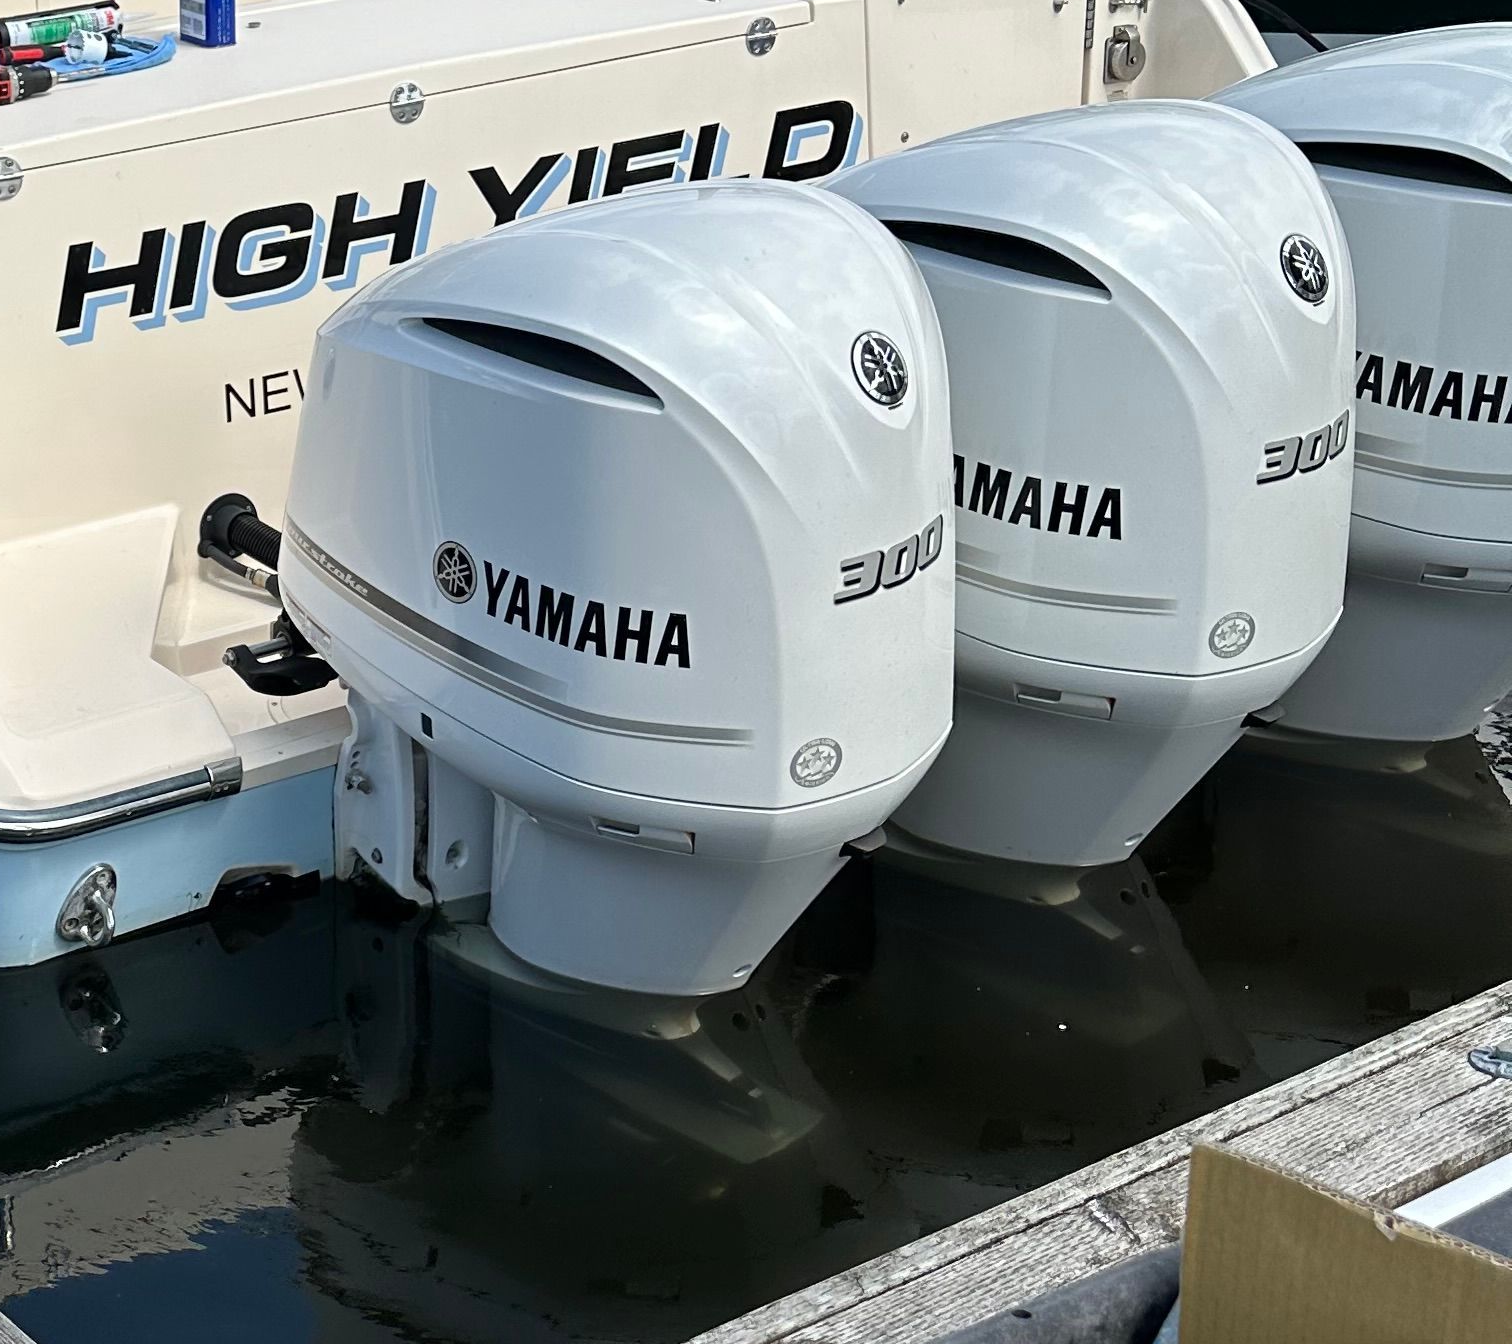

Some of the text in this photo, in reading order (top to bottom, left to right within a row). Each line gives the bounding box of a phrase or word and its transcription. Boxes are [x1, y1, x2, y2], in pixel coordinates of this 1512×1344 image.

[103, 9, 115, 27] 3M
[55, 99, 865, 346] HIGH YIELD
[1355, 350, 1512, 425] AMAH
[1256, 408, 1350, 485] 300
[833, 513, 944, 605] 300
[483, 559, 691, 669] YAMAHA
